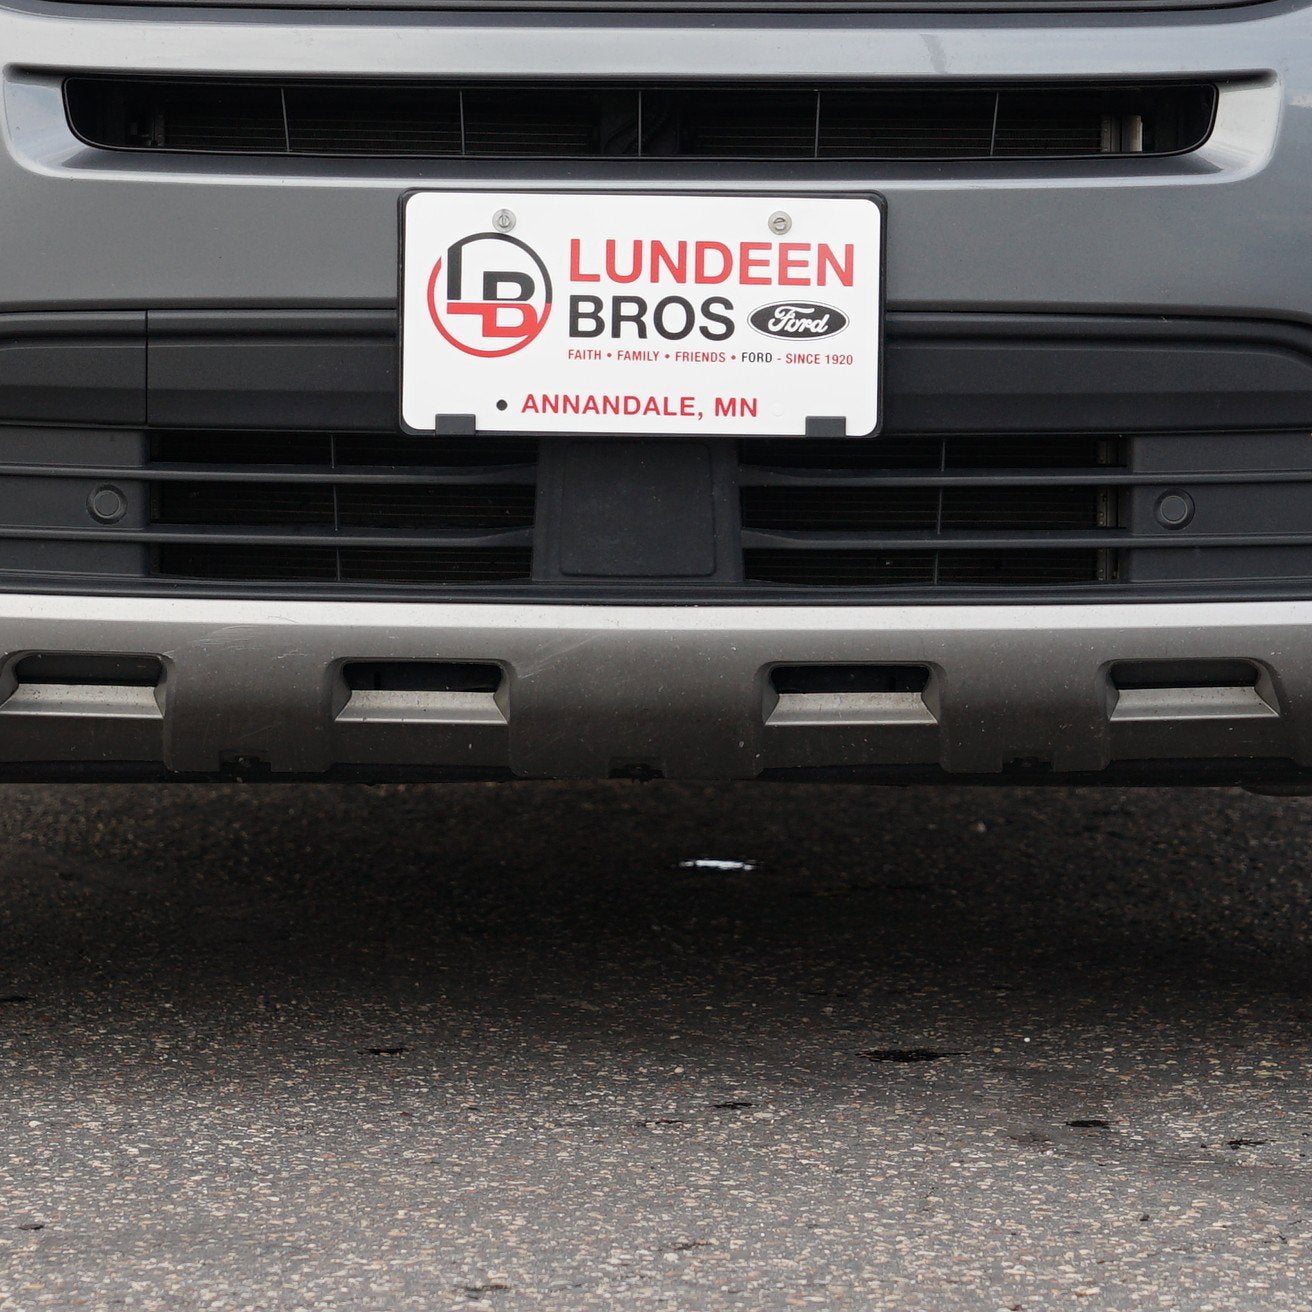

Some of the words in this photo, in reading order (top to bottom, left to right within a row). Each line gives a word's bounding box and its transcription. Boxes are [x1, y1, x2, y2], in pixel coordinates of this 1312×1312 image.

[568, 238, 855, 287] LUNDEEN
[568, 294, 736, 342] BROS
[767, 305, 830, 333] Ford
[568, 349, 602, 360] FAITH
[617, 350, 660, 362] FAMILY
[675, 351, 726, 363] FRIENDS
[741, 351, 773, 363] FORD
[785, 353, 820, 365] SINCE
[825, 354, 853, 366] 1920
[521, 393, 704, 421] ANNANDALE,
[714, 397, 758, 418] MN
